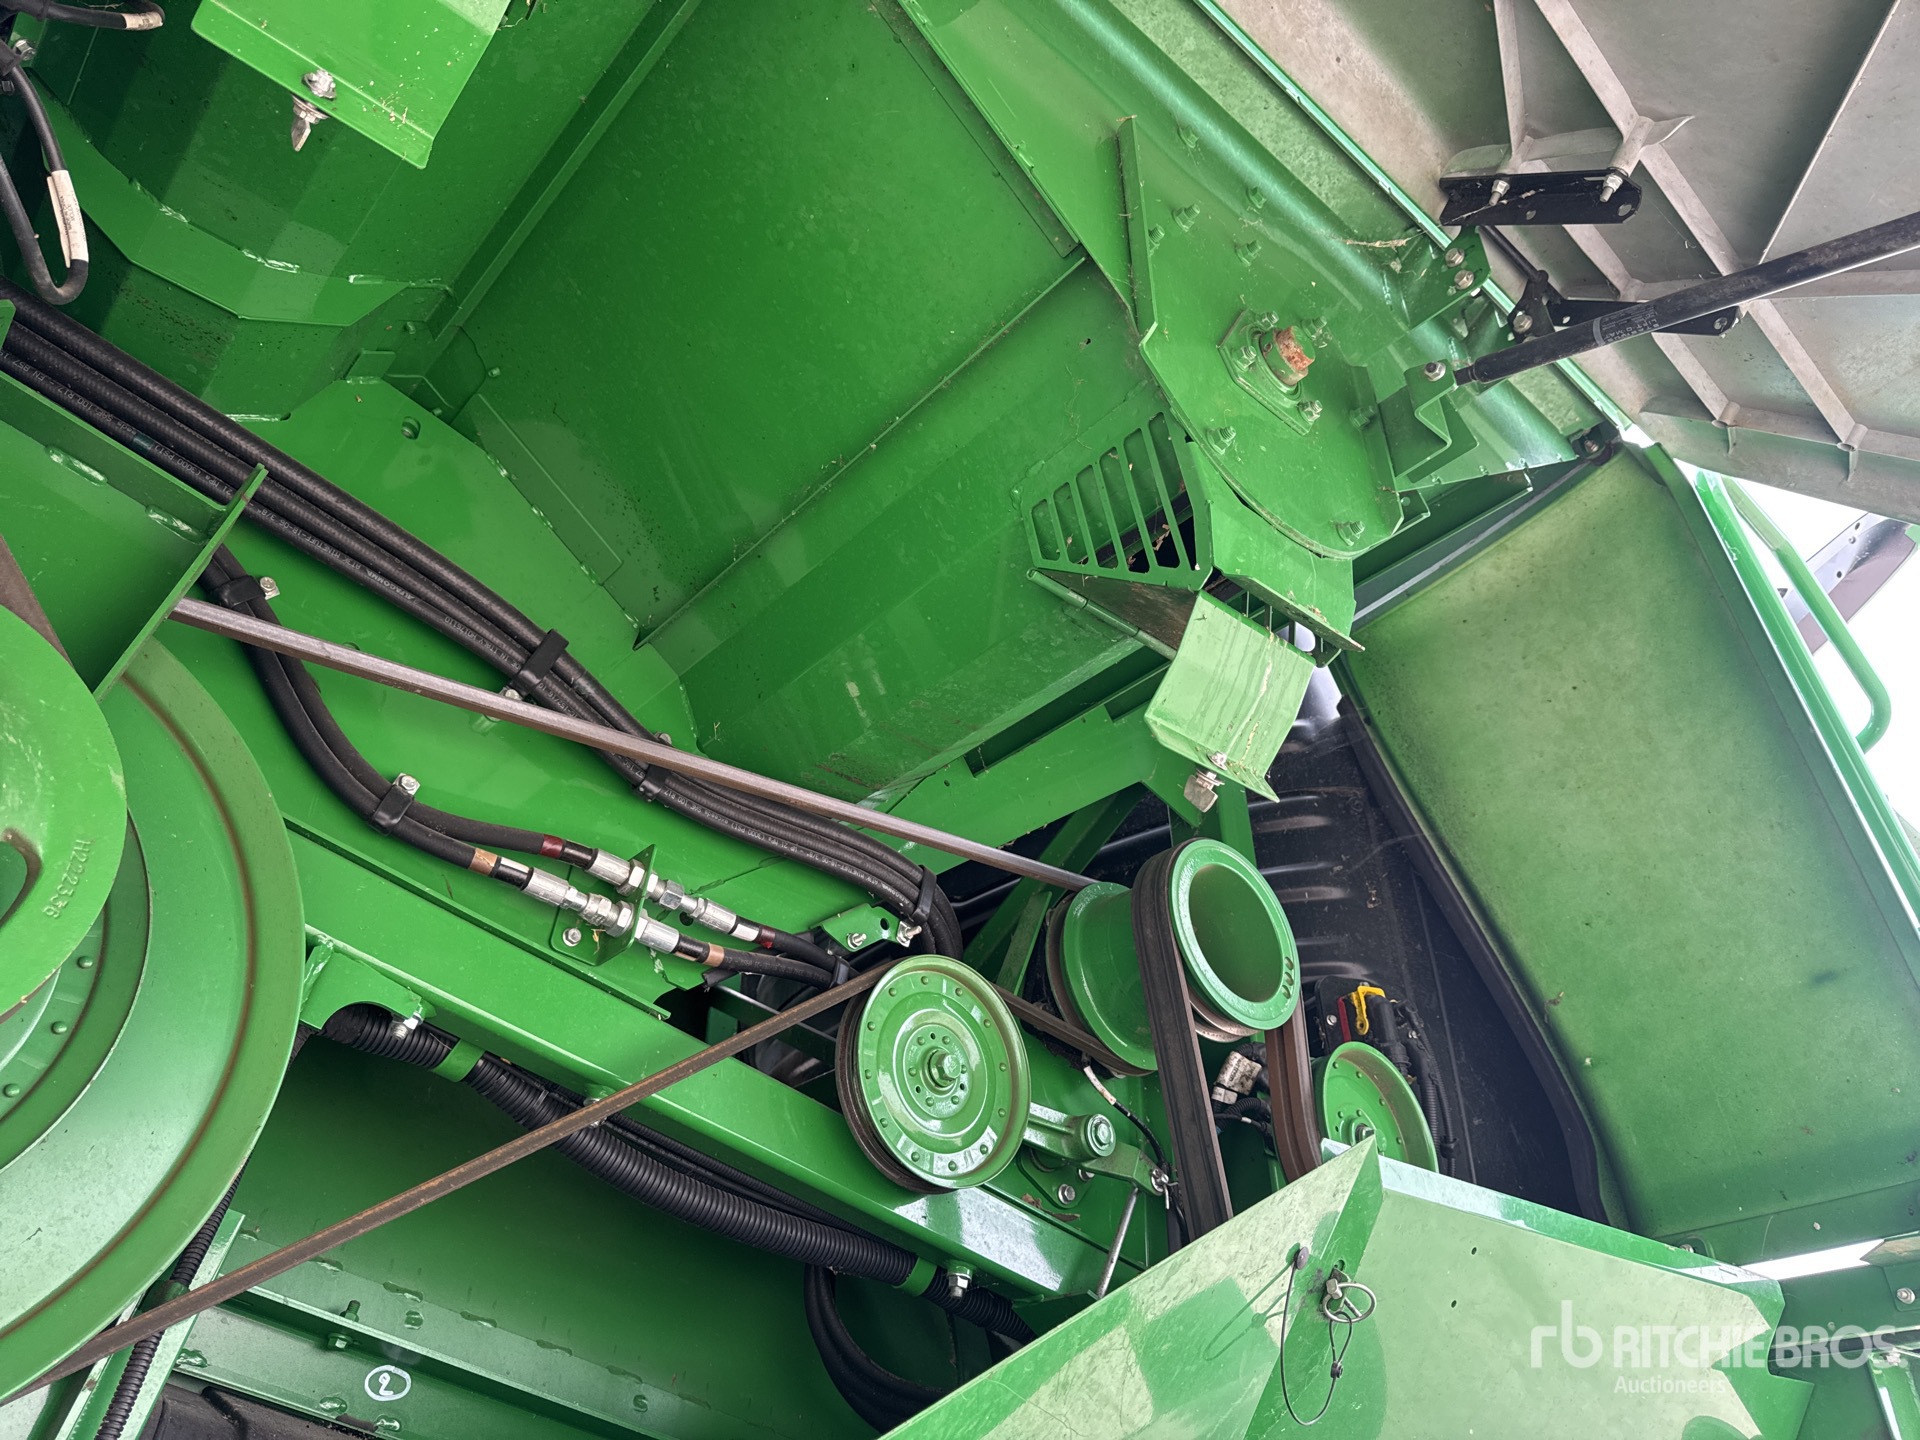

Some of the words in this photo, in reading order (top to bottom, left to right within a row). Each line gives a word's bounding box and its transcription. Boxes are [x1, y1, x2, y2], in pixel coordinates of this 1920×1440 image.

[11, 356, 32, 373] 857
[31, 368, 47, 383] EN
[56, 384, 75, 400] R17
[75, 395, 94, 411] 100
[152, 443, 176, 460] PSI)
[221, 484, 233, 495] 21
[363, 567, 416, 602] ALFAGOMMA
[476, 636, 499, 654] ITALY
[675, 795, 690, 807] 100
[42, 839, 91, 919] H222336
[378, 1372, 394, 1396] 2
